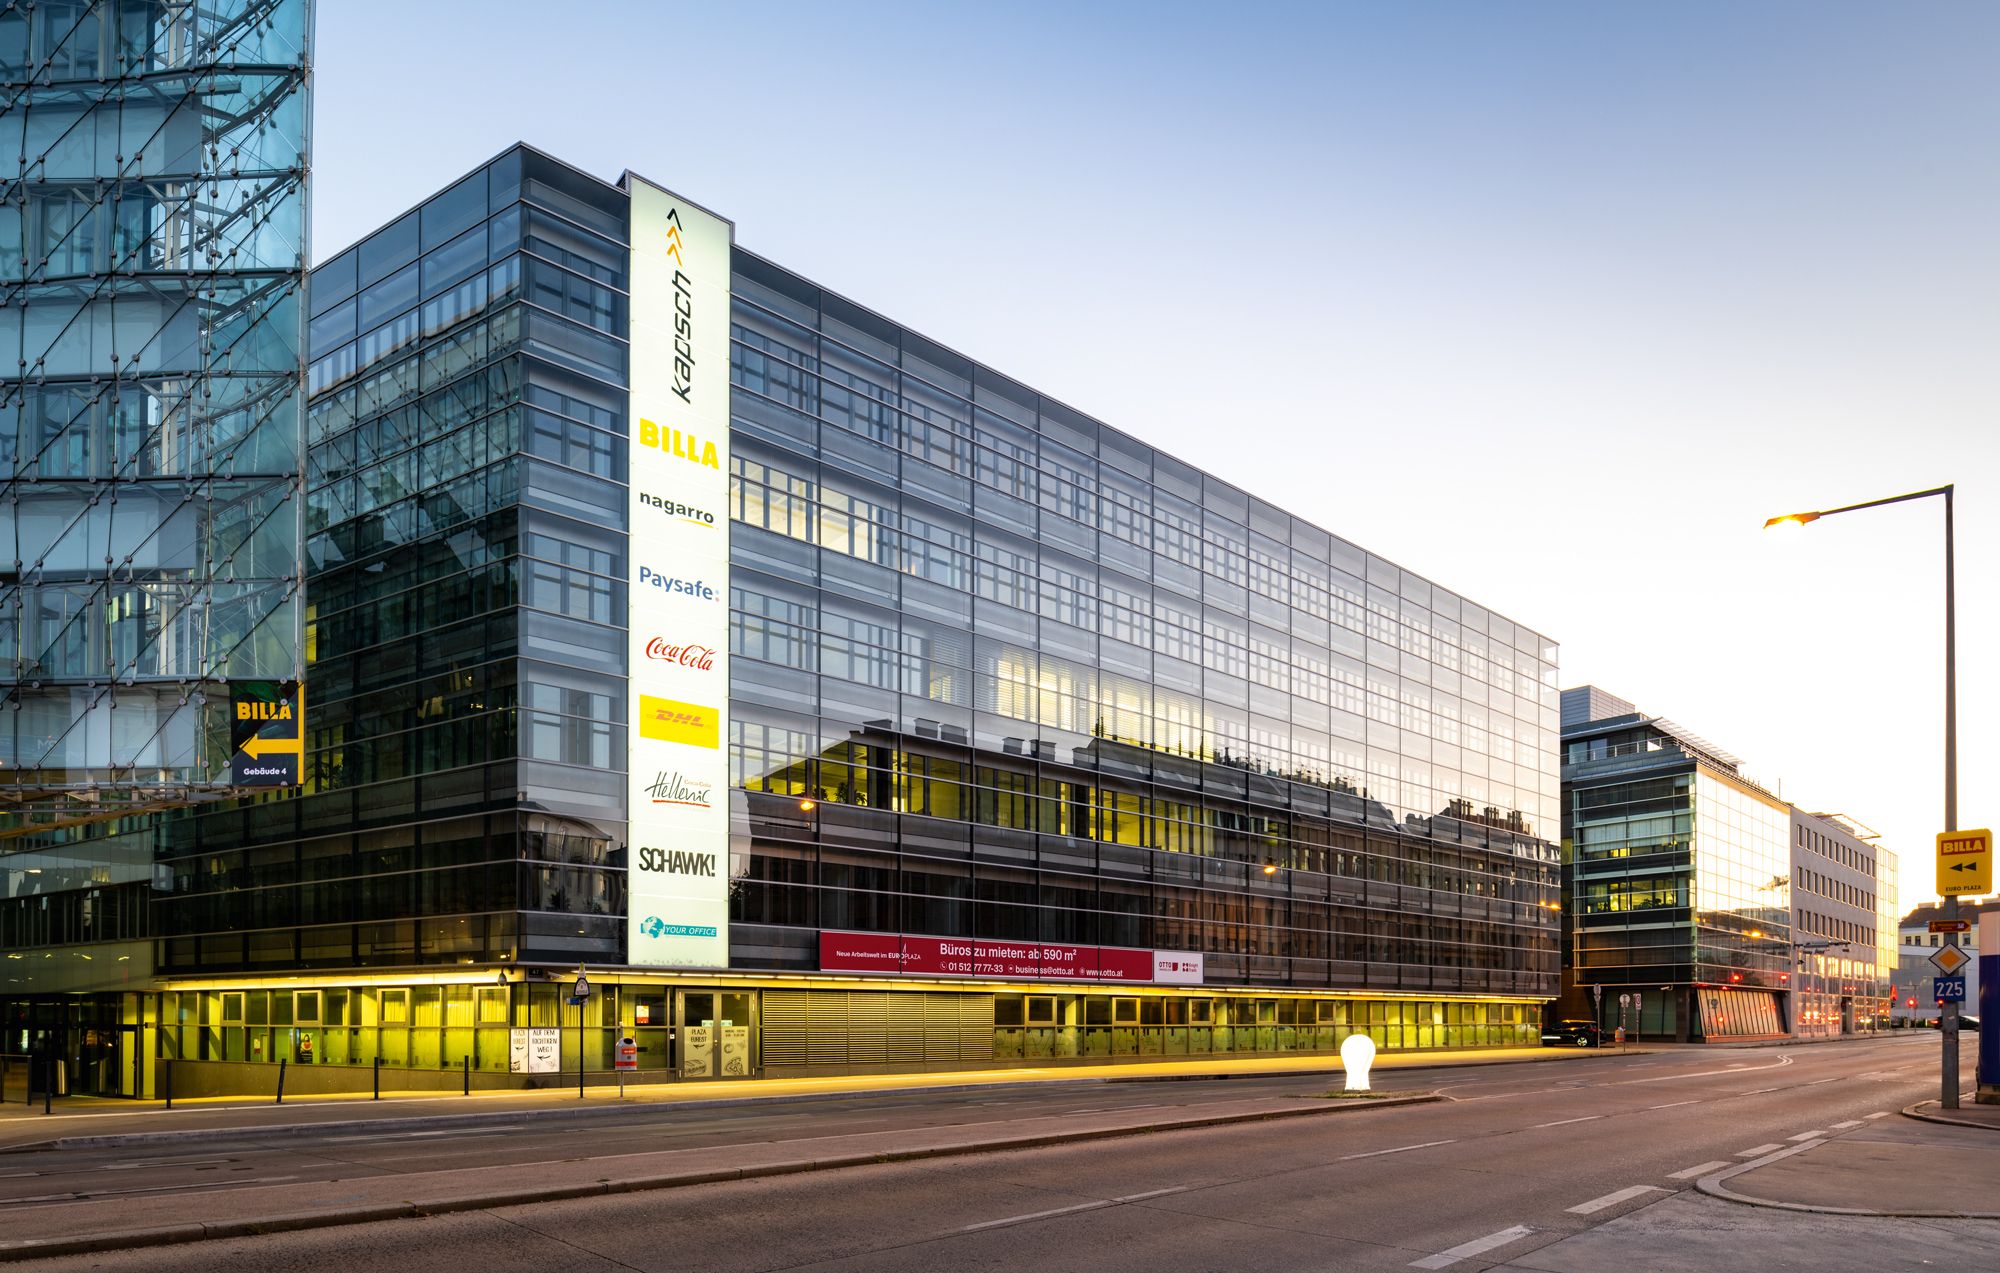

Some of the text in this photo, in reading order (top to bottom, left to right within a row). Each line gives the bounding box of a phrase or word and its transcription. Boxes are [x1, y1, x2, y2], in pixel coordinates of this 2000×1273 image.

[671, 269, 695, 404] kapsch
[639, 417, 719, 470] BILLA
[640, 492, 714, 524] nagarro
[237, 702, 292, 720] BILLA
[656, 709, 704, 727] DHL
[243, 767, 287, 775] Gebäude 4
[644, 771, 711, 803] Hellenic
[1943, 838, 1983, 854] BILLA
[639, 847, 716, 877] SCHAWK!
[665, 926, 717, 936] YOUR OFFICE
[940, 943, 972, 957] Büros
[974, 947, 986, 957] zu
[988, 947, 1026, 959] mieten:
[1028, 949, 1041, 960] ab
[1043, 949, 1062, 961] 590
[948, 962, 1004, 973] 01 512 77 77-33
[1015, 964, 1074, 976] business@otto.at
[1936, 981, 1964, 997] 225
